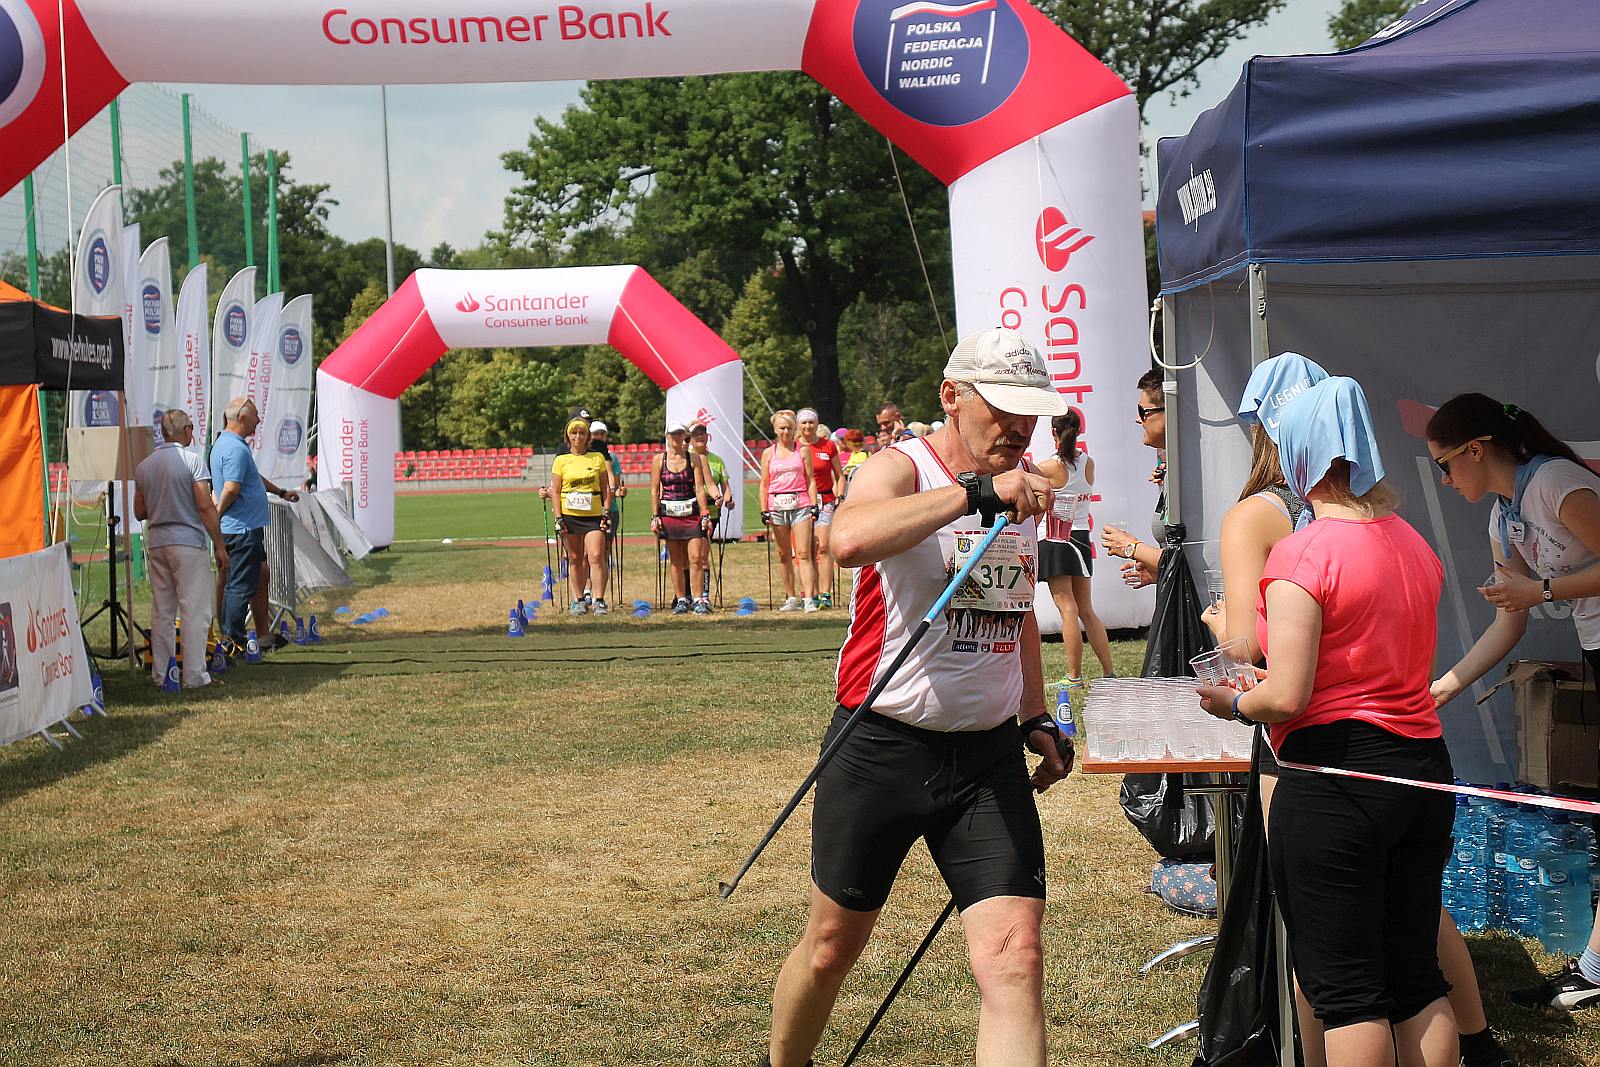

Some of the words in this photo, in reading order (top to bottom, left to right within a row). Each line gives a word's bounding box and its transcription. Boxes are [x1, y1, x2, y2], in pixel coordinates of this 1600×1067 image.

[321, 9, 549, 45] Consumer
[558, 2, 673, 40] Bank
[906, 21, 962, 36] POLSKA
[903, 37, 984, 54] FEDERACJA
[900, 56, 954, 71] NORDIC
[899, 73, 961, 89] WALKING
[484, 292, 589, 312] Santander
[484, 314, 553, 329] Consumer
[555, 314, 589, 327] Bank
[357, 418, 369, 448] Bank
[357, 452, 369, 509] Consumer
[980, 564, 1023, 590] 317
